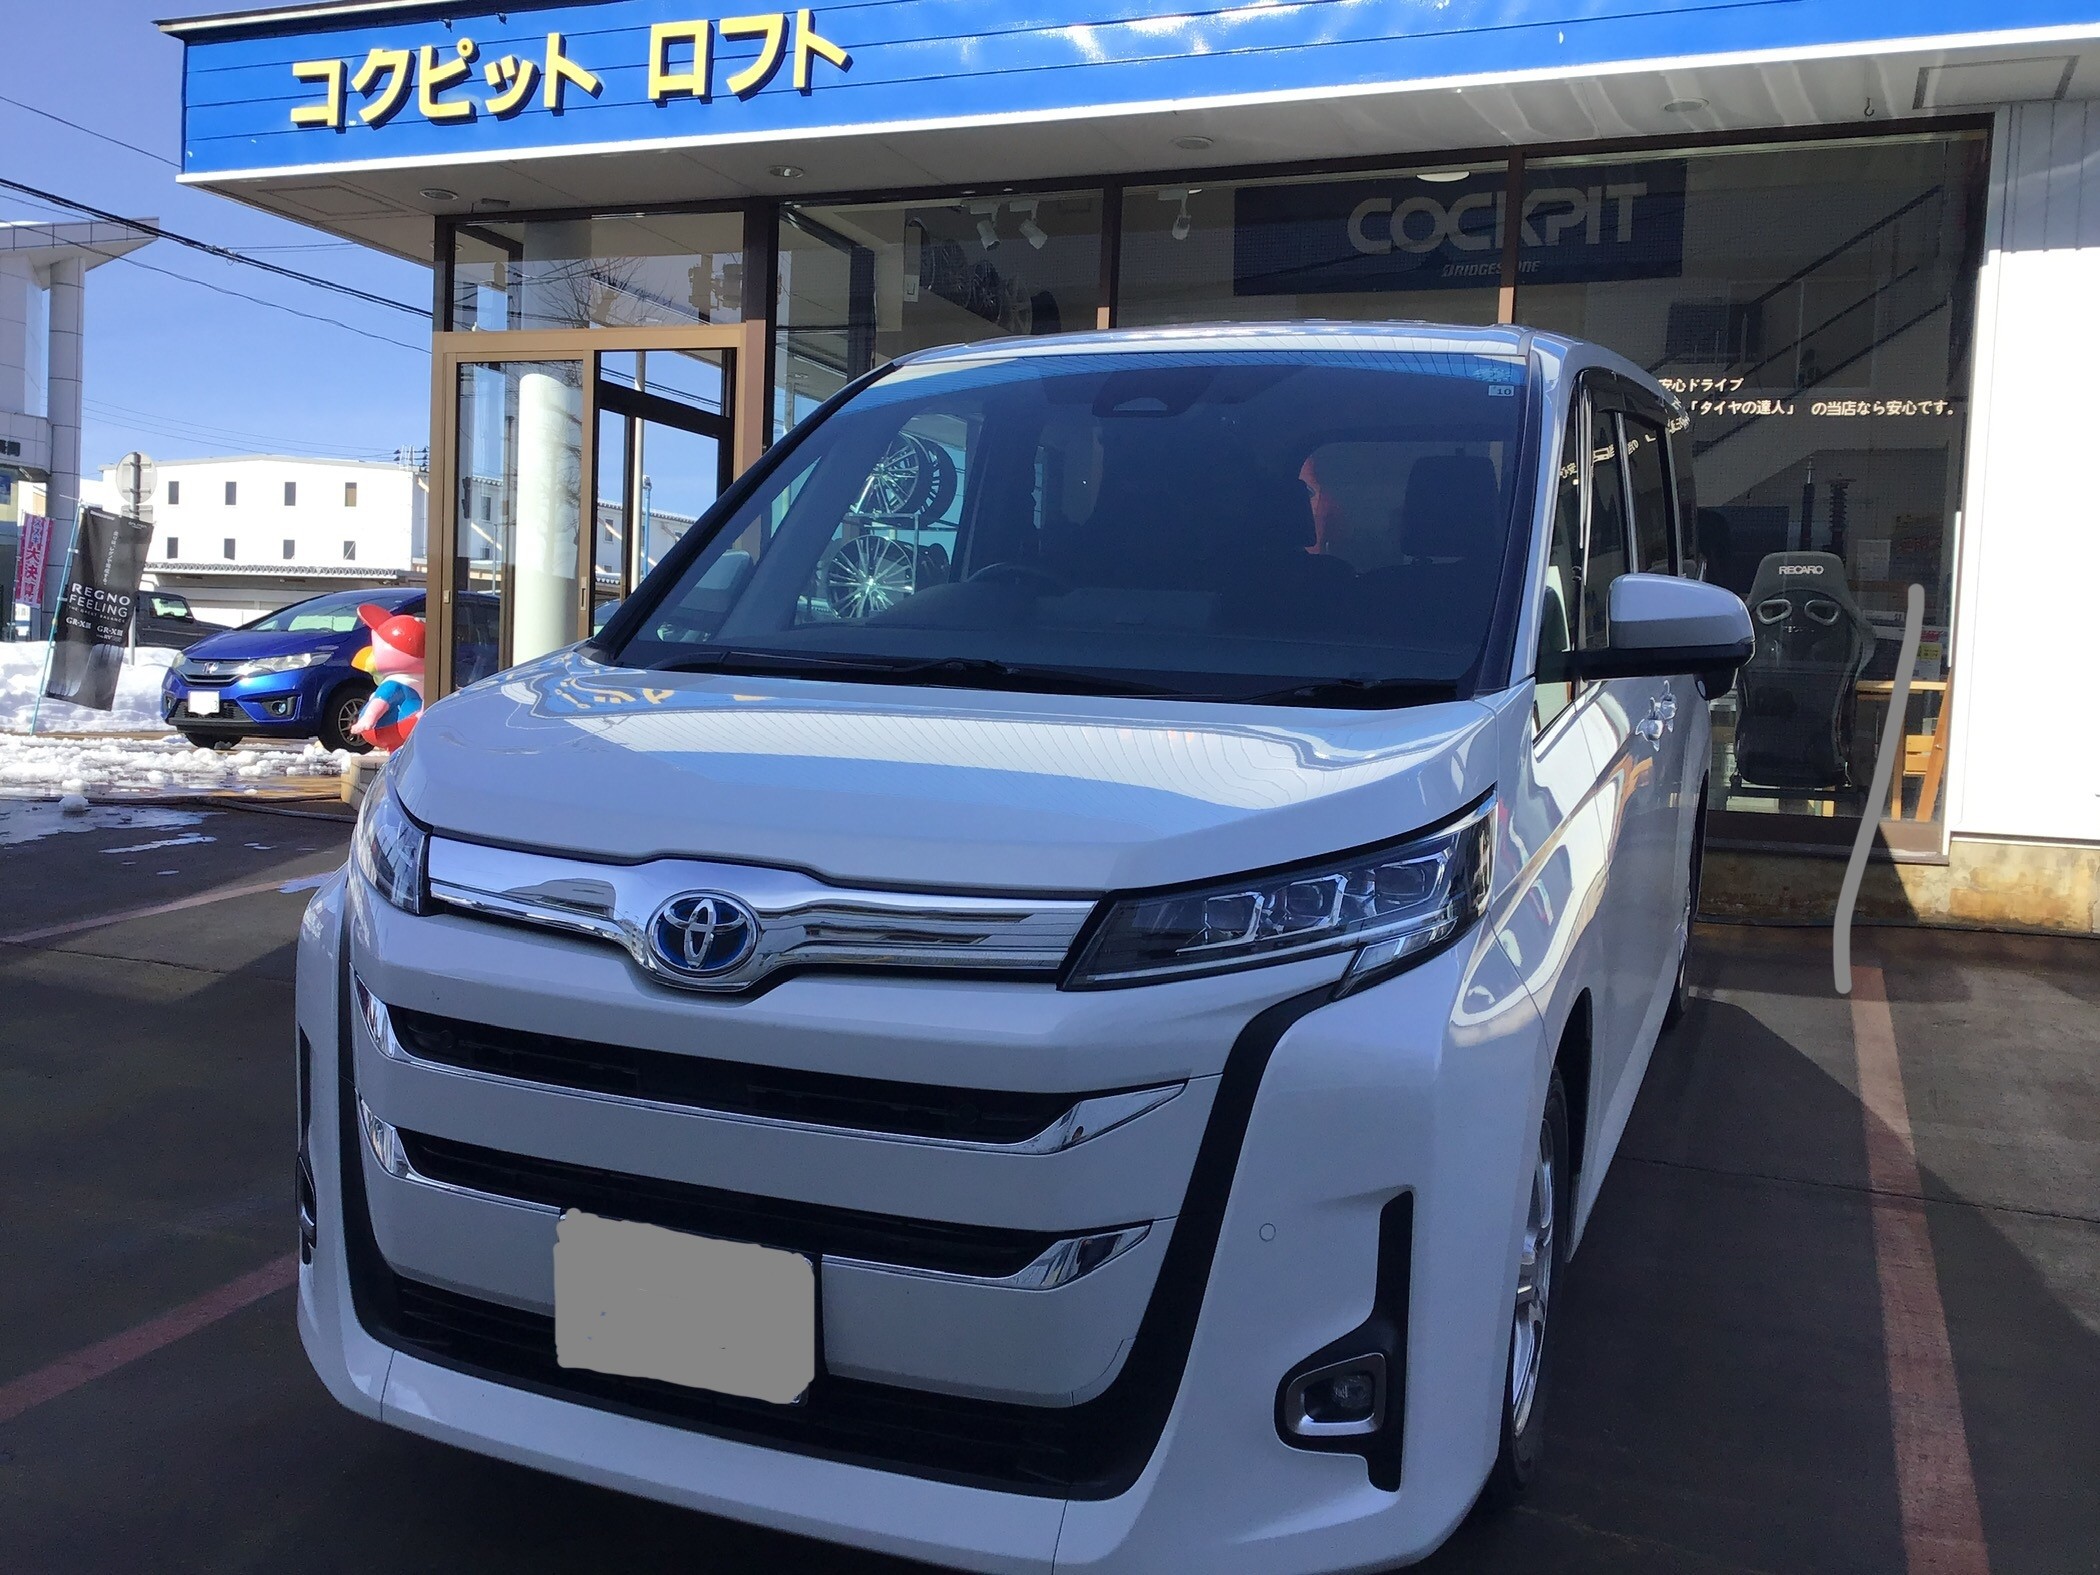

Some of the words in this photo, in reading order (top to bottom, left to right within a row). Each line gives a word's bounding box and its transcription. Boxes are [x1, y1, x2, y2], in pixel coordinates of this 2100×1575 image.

[291, 33, 601, 128] コクピット
[649, 8, 849, 101] ロフト
[1347, 181, 1648, 255] COCKPIT
[1441, 260, 1541, 278] BRIDGESNE
[1691, 400, 1796, 416] 「タイヤの達人」
[1811, 401, 1956, 417] の当店なら安心です。
[1778, 565, 1825, 575] RECARO
[69, 593, 128, 618] FEELING
[71, 582, 131, 606] REGNO
